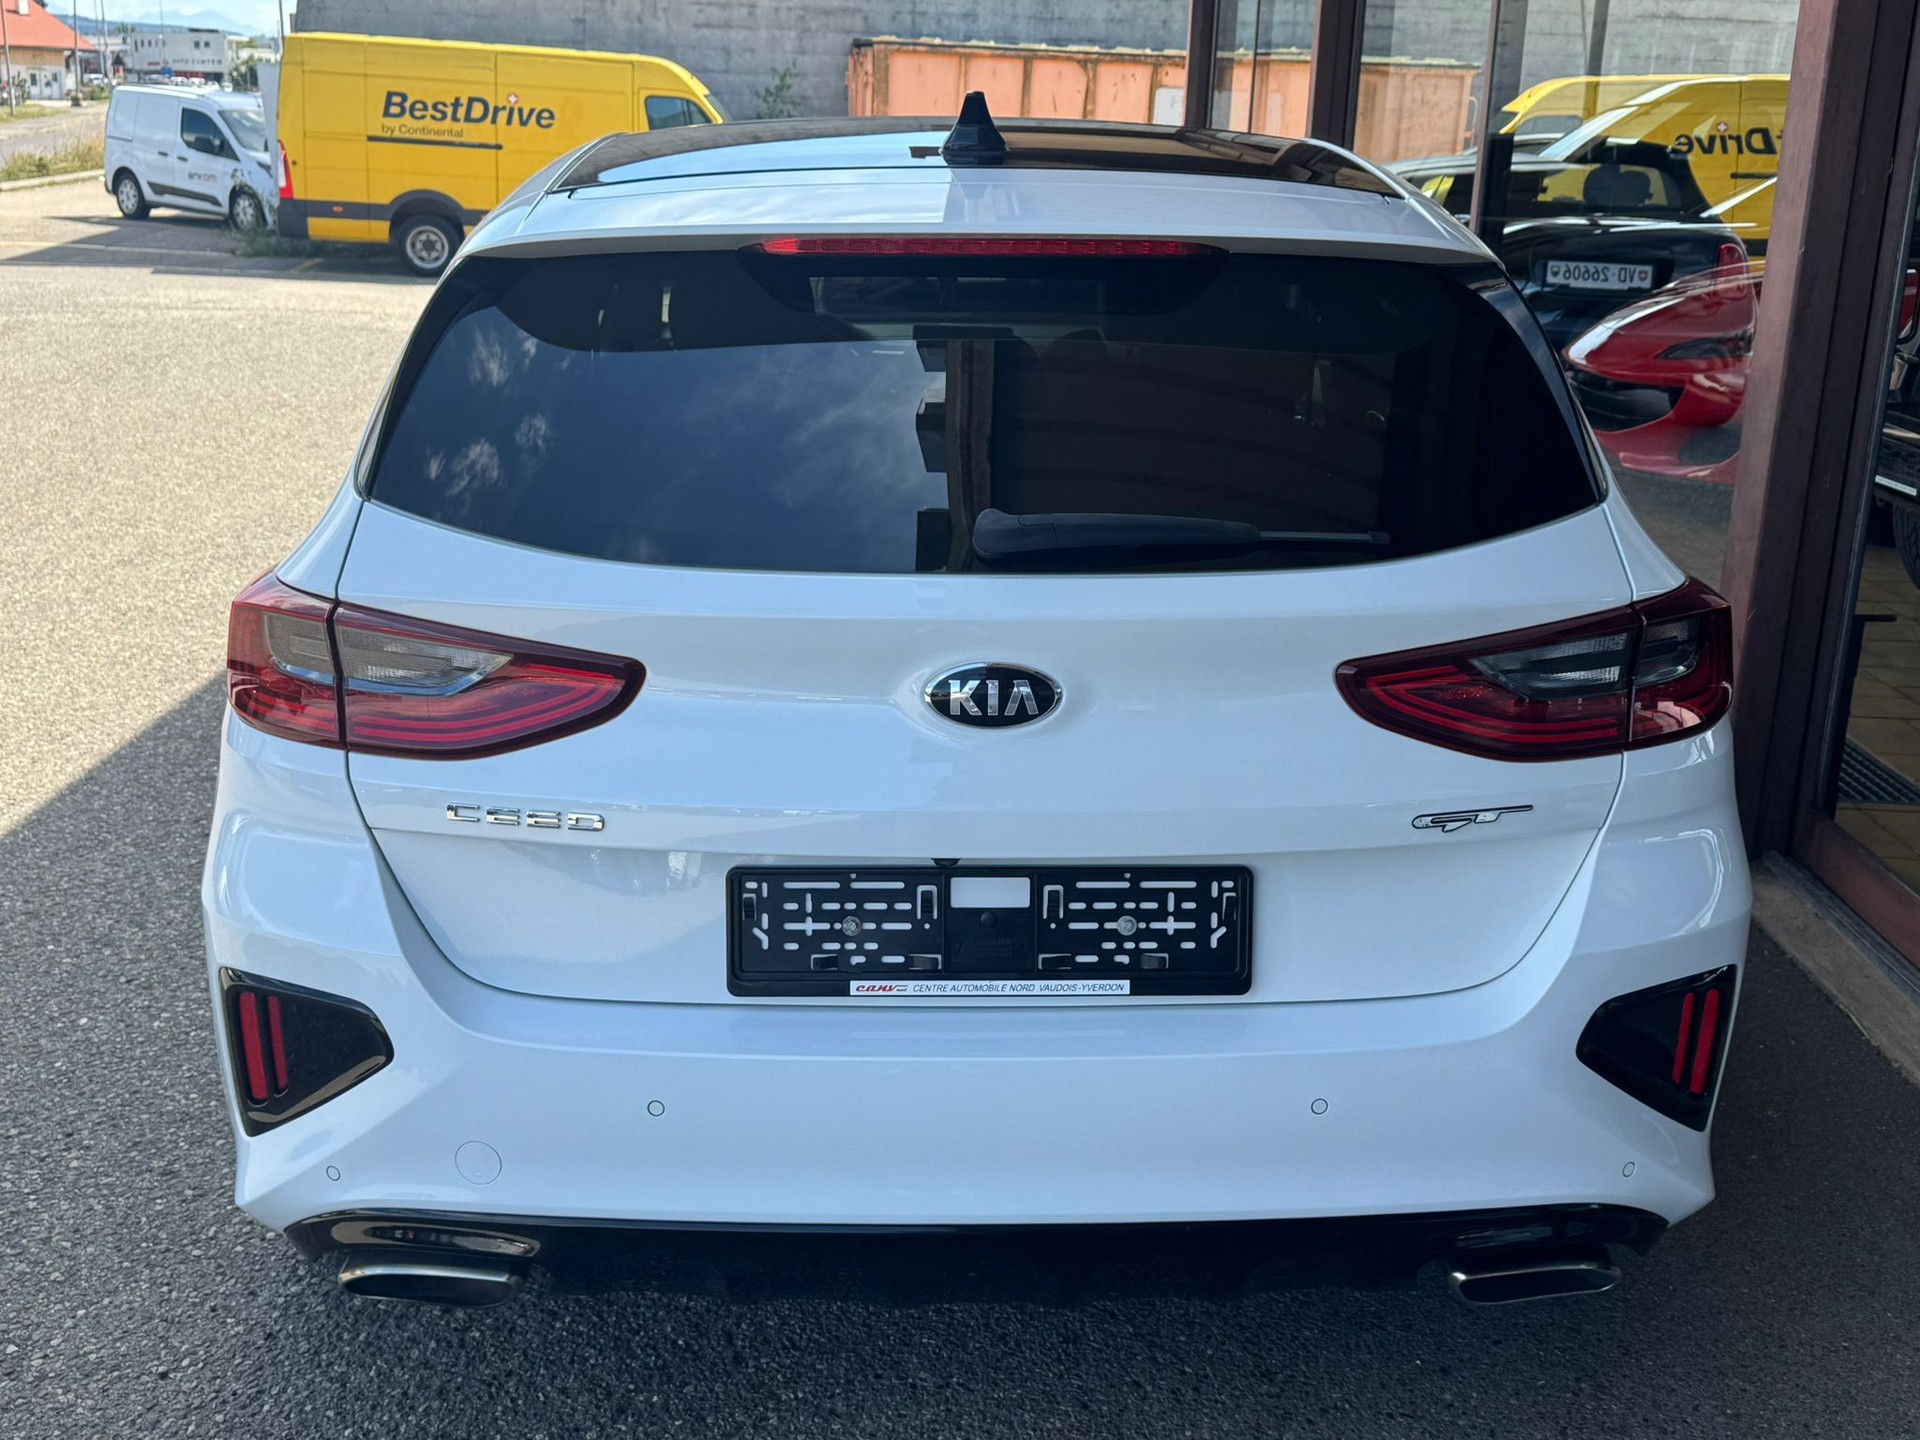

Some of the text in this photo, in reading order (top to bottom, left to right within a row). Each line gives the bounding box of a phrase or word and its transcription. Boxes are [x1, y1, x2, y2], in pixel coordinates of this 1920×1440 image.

[382, 90, 556, 129] BestDrive
[381, 123, 464, 138] by Continental
[948, 679, 1040, 716] KIA
[446, 802, 606, 832] CEED
[1411, 804, 1534, 833] GT
[913, 984, 948, 992] CENTRE
[950, 984, 1008, 992] AUTOMOBILE
[1009, 984, 1036, 992] NORD
[1040, 984, 1078, 992] VAUDOIS
